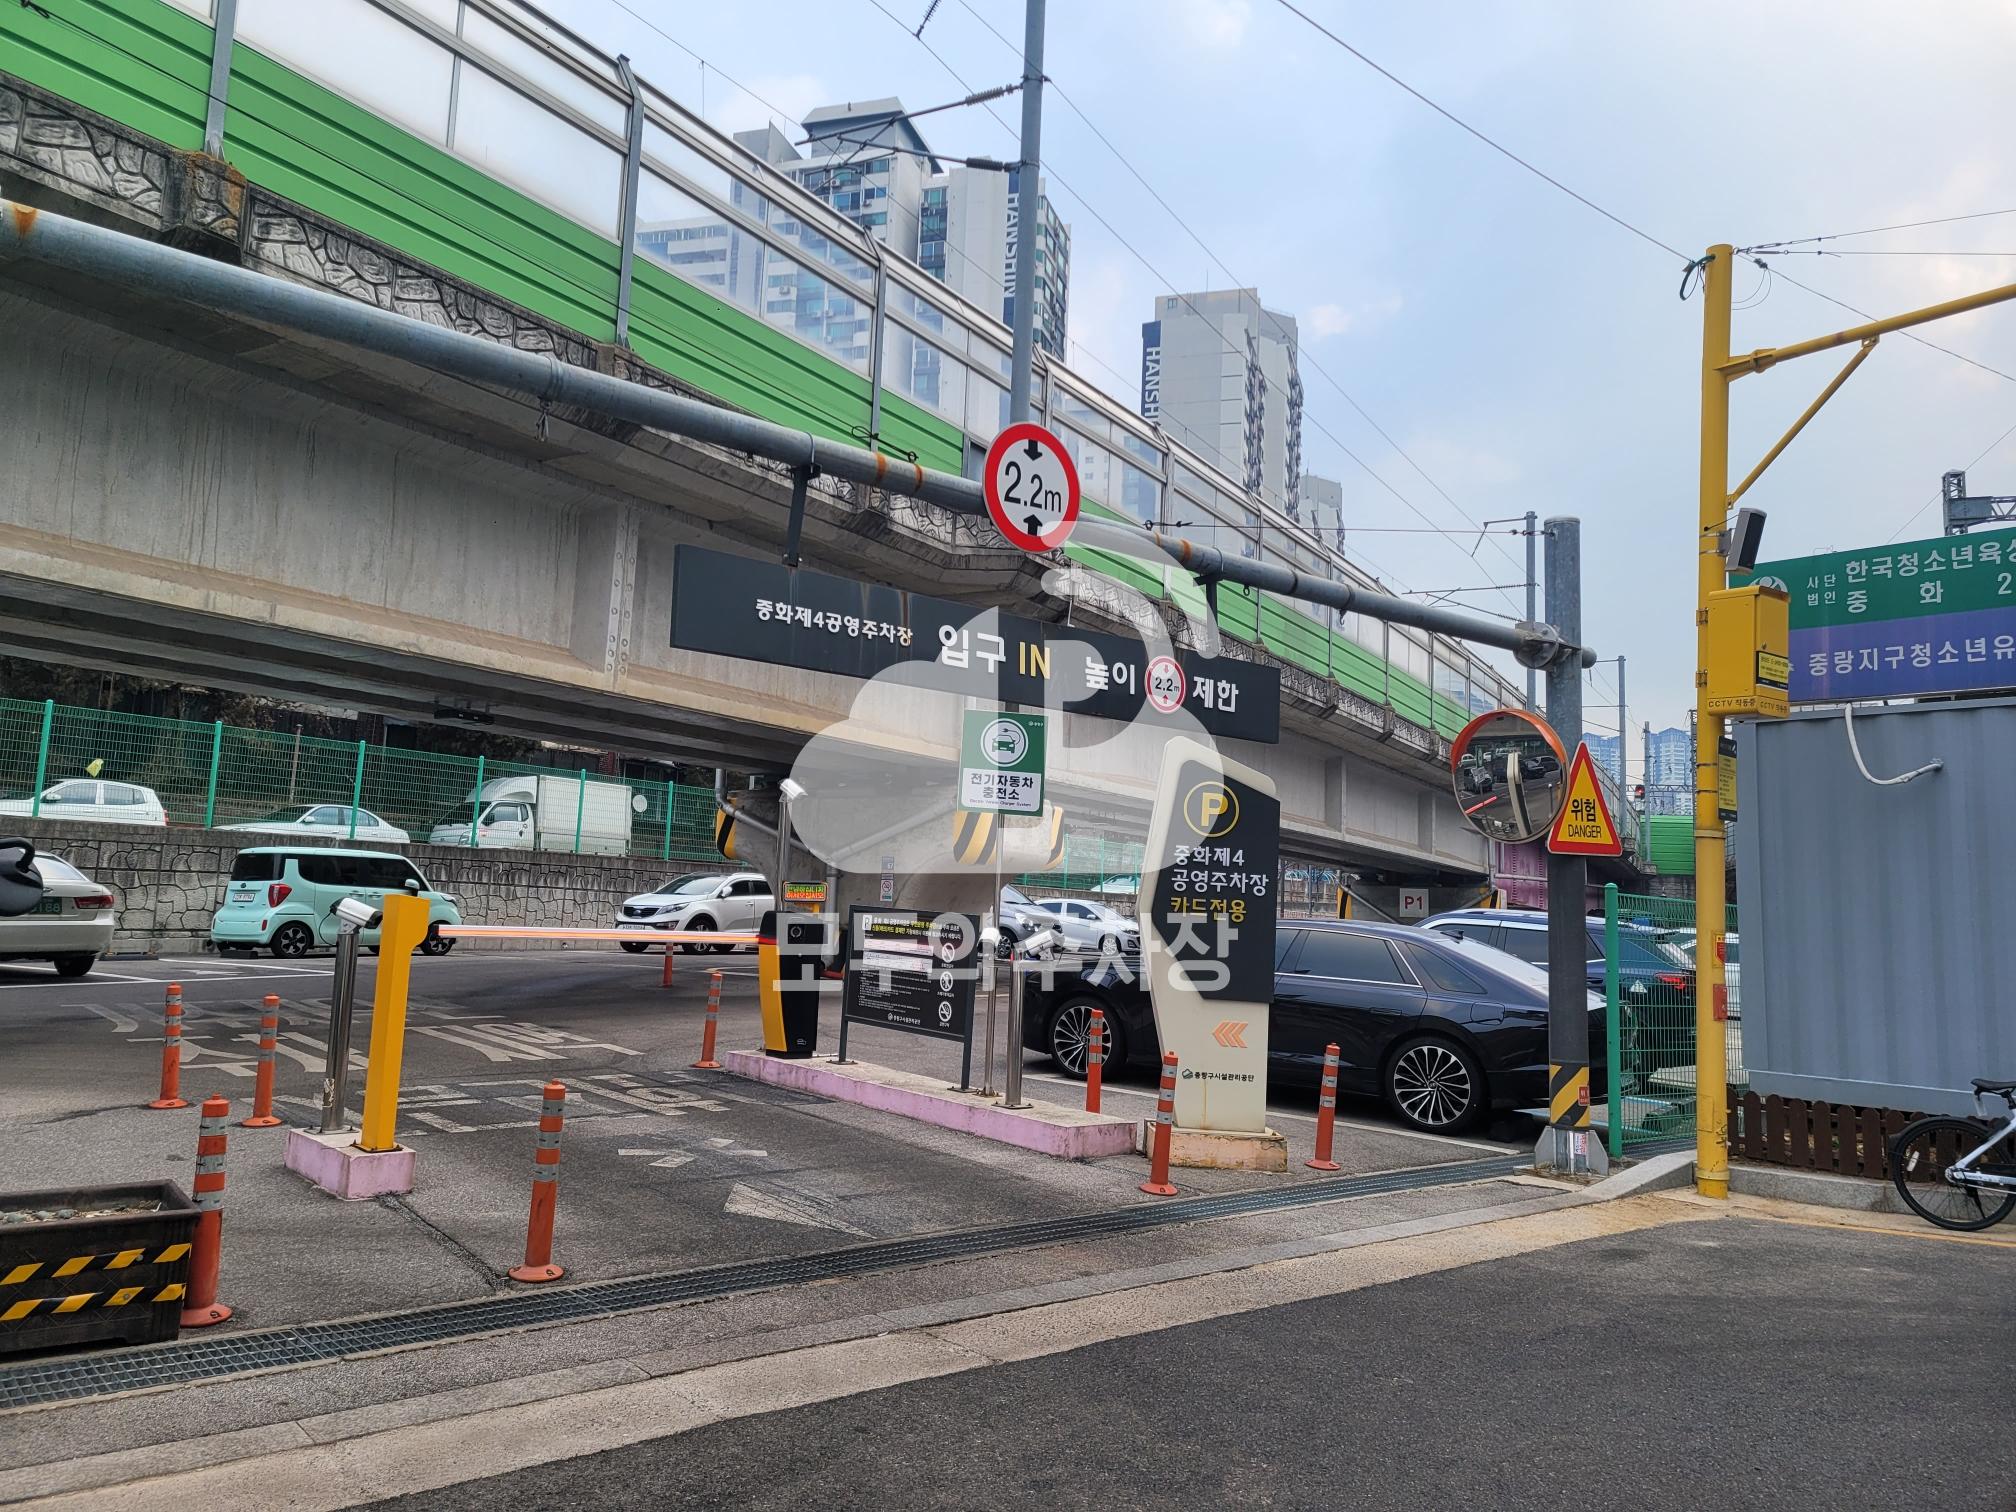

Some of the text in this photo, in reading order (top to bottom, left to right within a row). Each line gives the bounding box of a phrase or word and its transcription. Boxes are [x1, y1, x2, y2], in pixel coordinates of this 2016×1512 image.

[1004, 461, 1061, 512] 2.2m
[756, 599, 1239, 713] 중화제4공영주차장 입구 IN 높이 2.2m 제한
[1708, 700, 1733, 708] CCTV
[970, 772, 1034, 789] 전기자동차
[983, 786, 1020, 800] 충전소
[1201, 792, 1229, 827] P
[1571, 798, 1596, 822] 위험
[1568, 824, 1602, 838] DANGER
[1173, 845, 1245, 867] 중화제4
[1171, 869, 1269, 897] 공영주차장
[1170, 896, 1247, 923] 카드전용
[1404, 895, 1423, 910] P1
